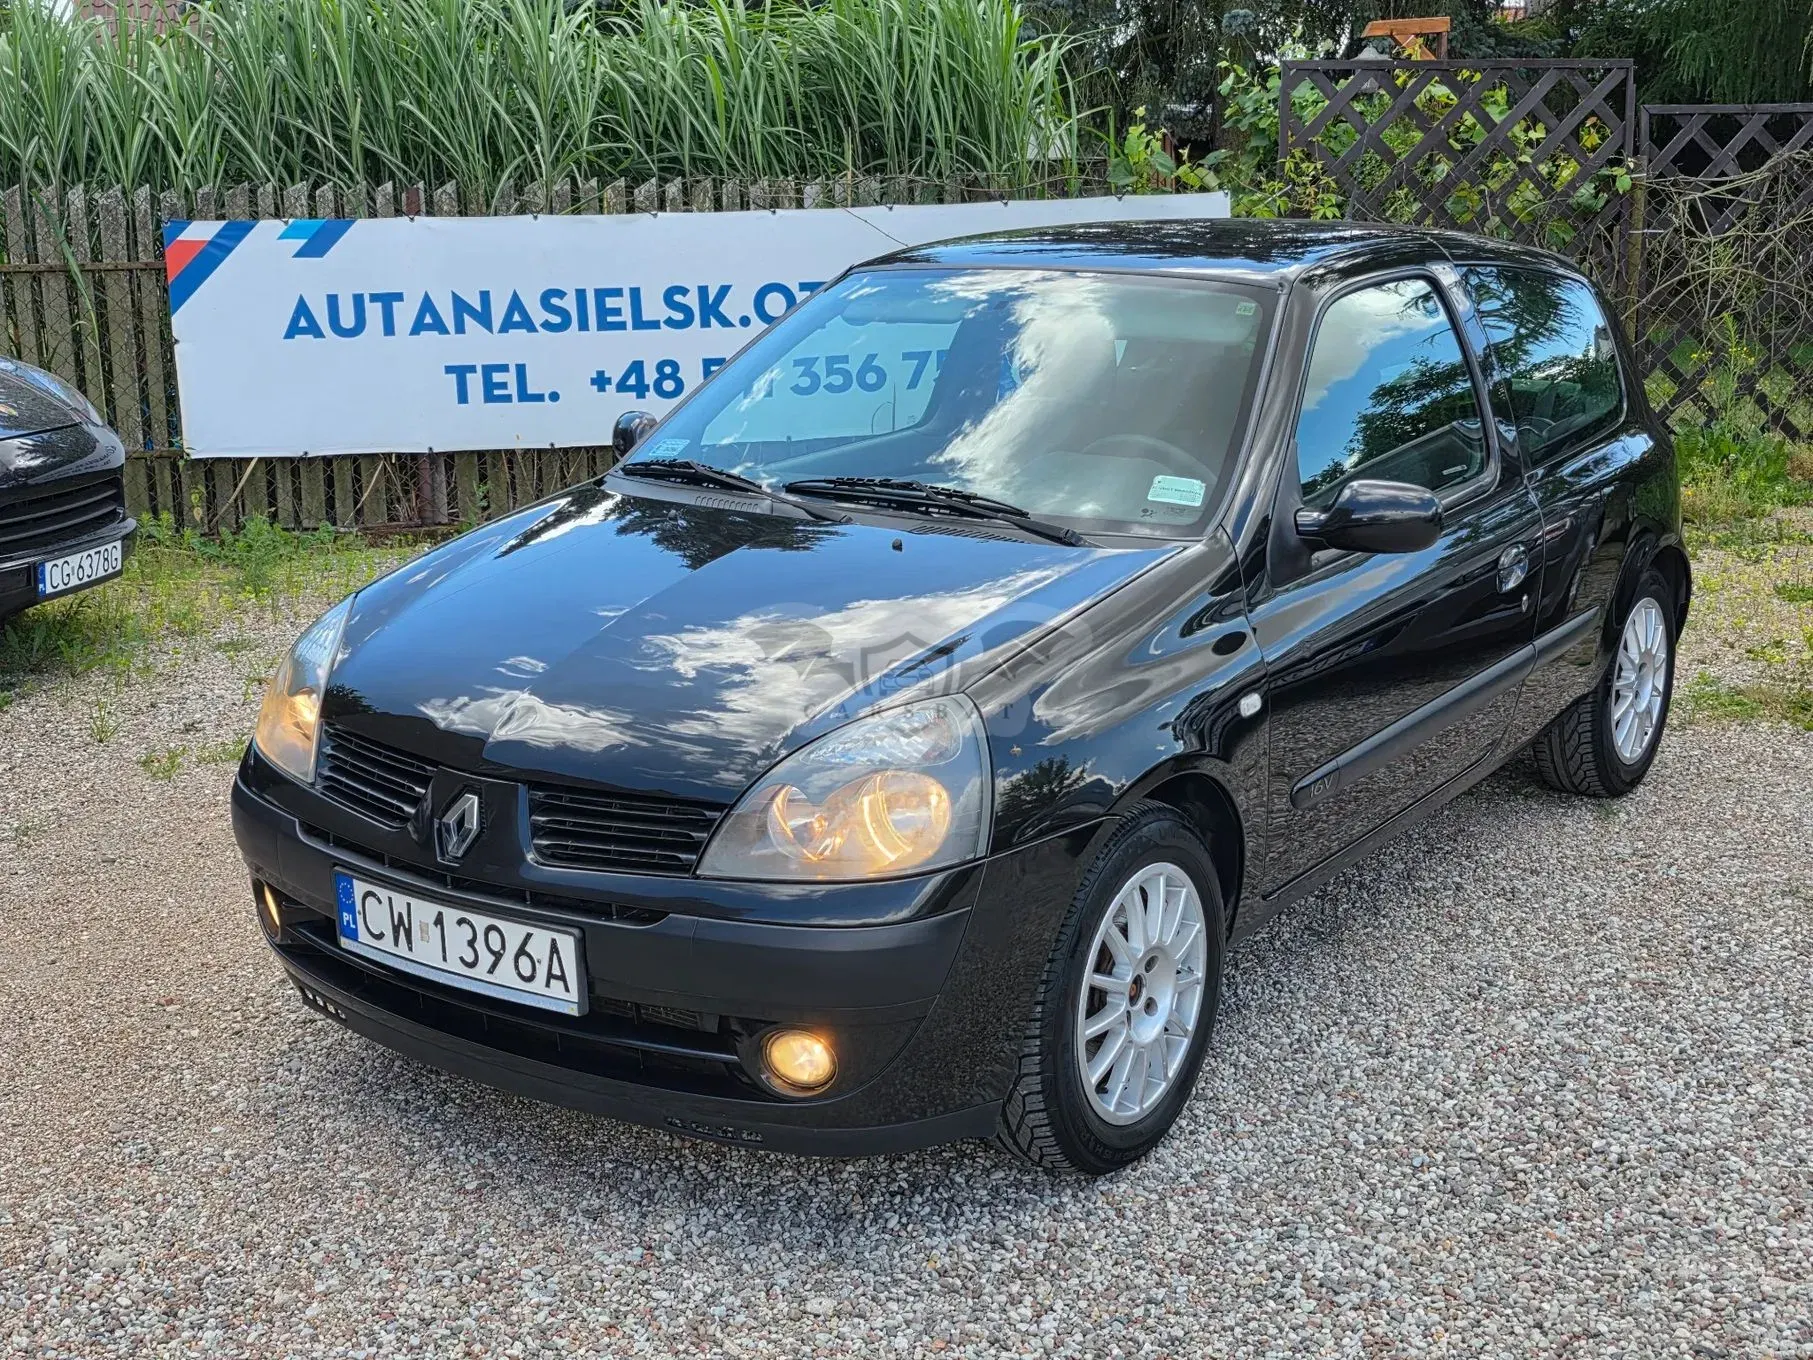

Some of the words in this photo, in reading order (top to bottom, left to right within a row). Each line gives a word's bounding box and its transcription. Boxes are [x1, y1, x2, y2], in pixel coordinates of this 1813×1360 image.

[444, 362, 560, 405] TEL.
[589, 358, 685, 400] +48
[789, 354, 888, 396] 356
[50, 560, 71, 590] CG
[77, 546, 118, 582] 6378G
[1310, 774, 1333, 798] 16V
[342, 911, 356, 929] PL
[361, 890, 413, 952] CW
[433, 910, 570, 993] 1396A
